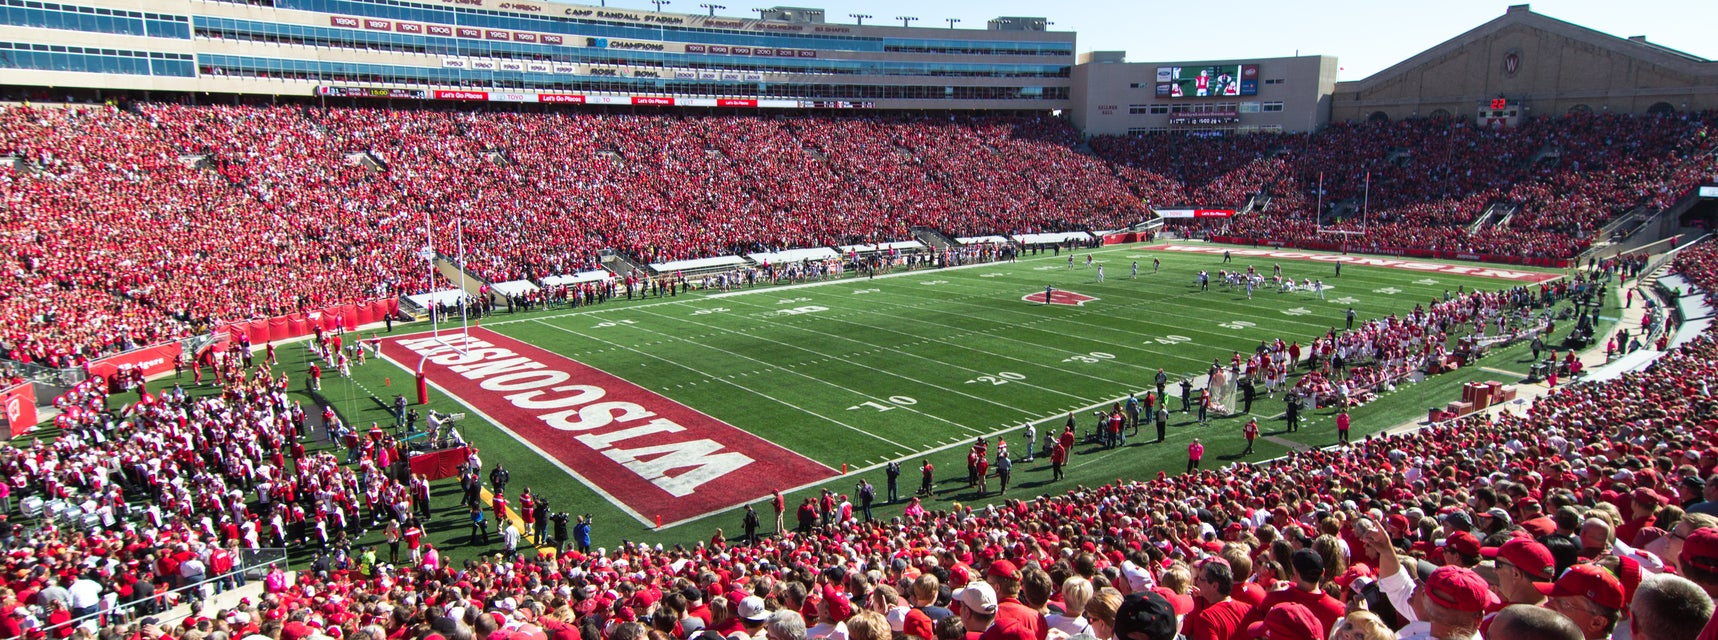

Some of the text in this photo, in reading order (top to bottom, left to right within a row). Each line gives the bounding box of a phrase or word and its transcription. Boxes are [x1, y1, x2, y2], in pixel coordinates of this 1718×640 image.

[565, 8, 683, 24] CAMP RANDALL STADIUM
[610, 41, 664, 50] CHAMPIONS
[1507, 58, 1519, 72] W
[590, 68, 660, 78] ROSE BOWL
[1491, 98, 1505, 110] 22
[1163, 245, 1536, 279] WISCONSIN
[1070, 351, 1116, 364] 30
[976, 371, 1026, 386] 20
[859, 395, 917, 412] 10
[395, 332, 756, 498] WISCONSIN
